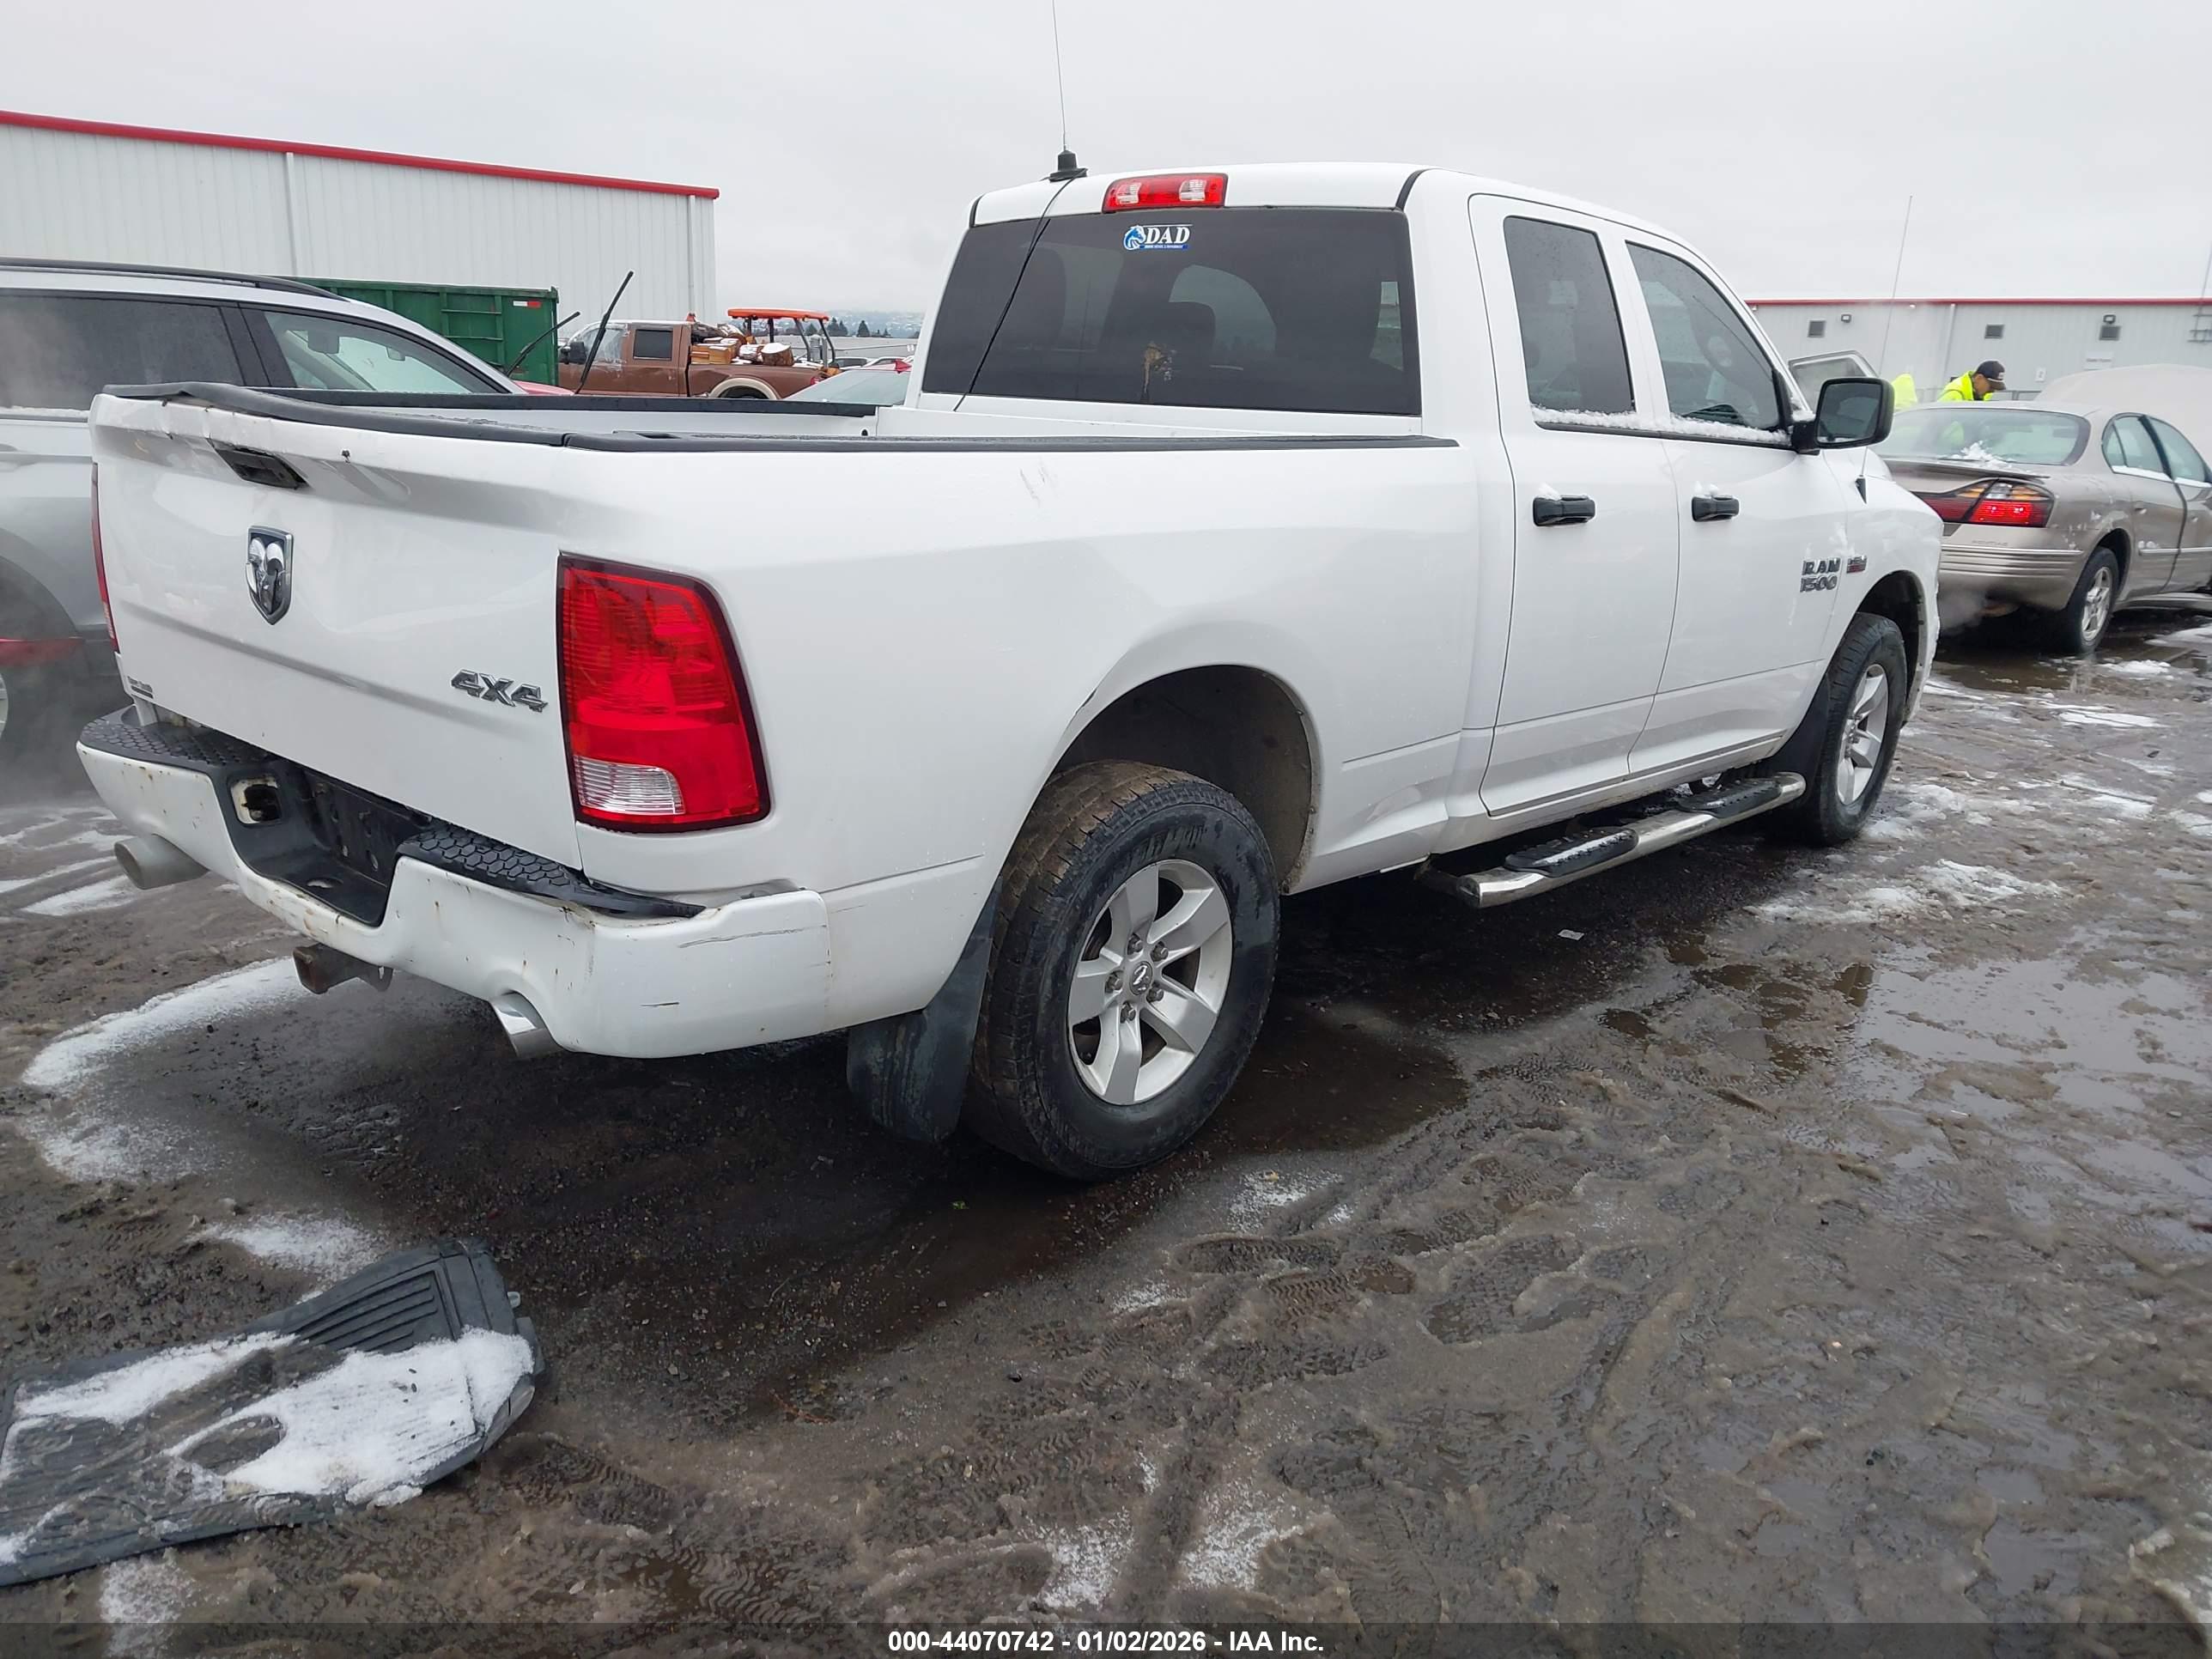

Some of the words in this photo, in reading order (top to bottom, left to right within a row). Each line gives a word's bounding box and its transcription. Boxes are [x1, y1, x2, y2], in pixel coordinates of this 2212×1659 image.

[1145, 227, 1190, 244] DAD
[1802, 557, 1841, 575] RAM
[1800, 575, 1838, 592] 1500
[451, 669, 549, 714] 4X4
